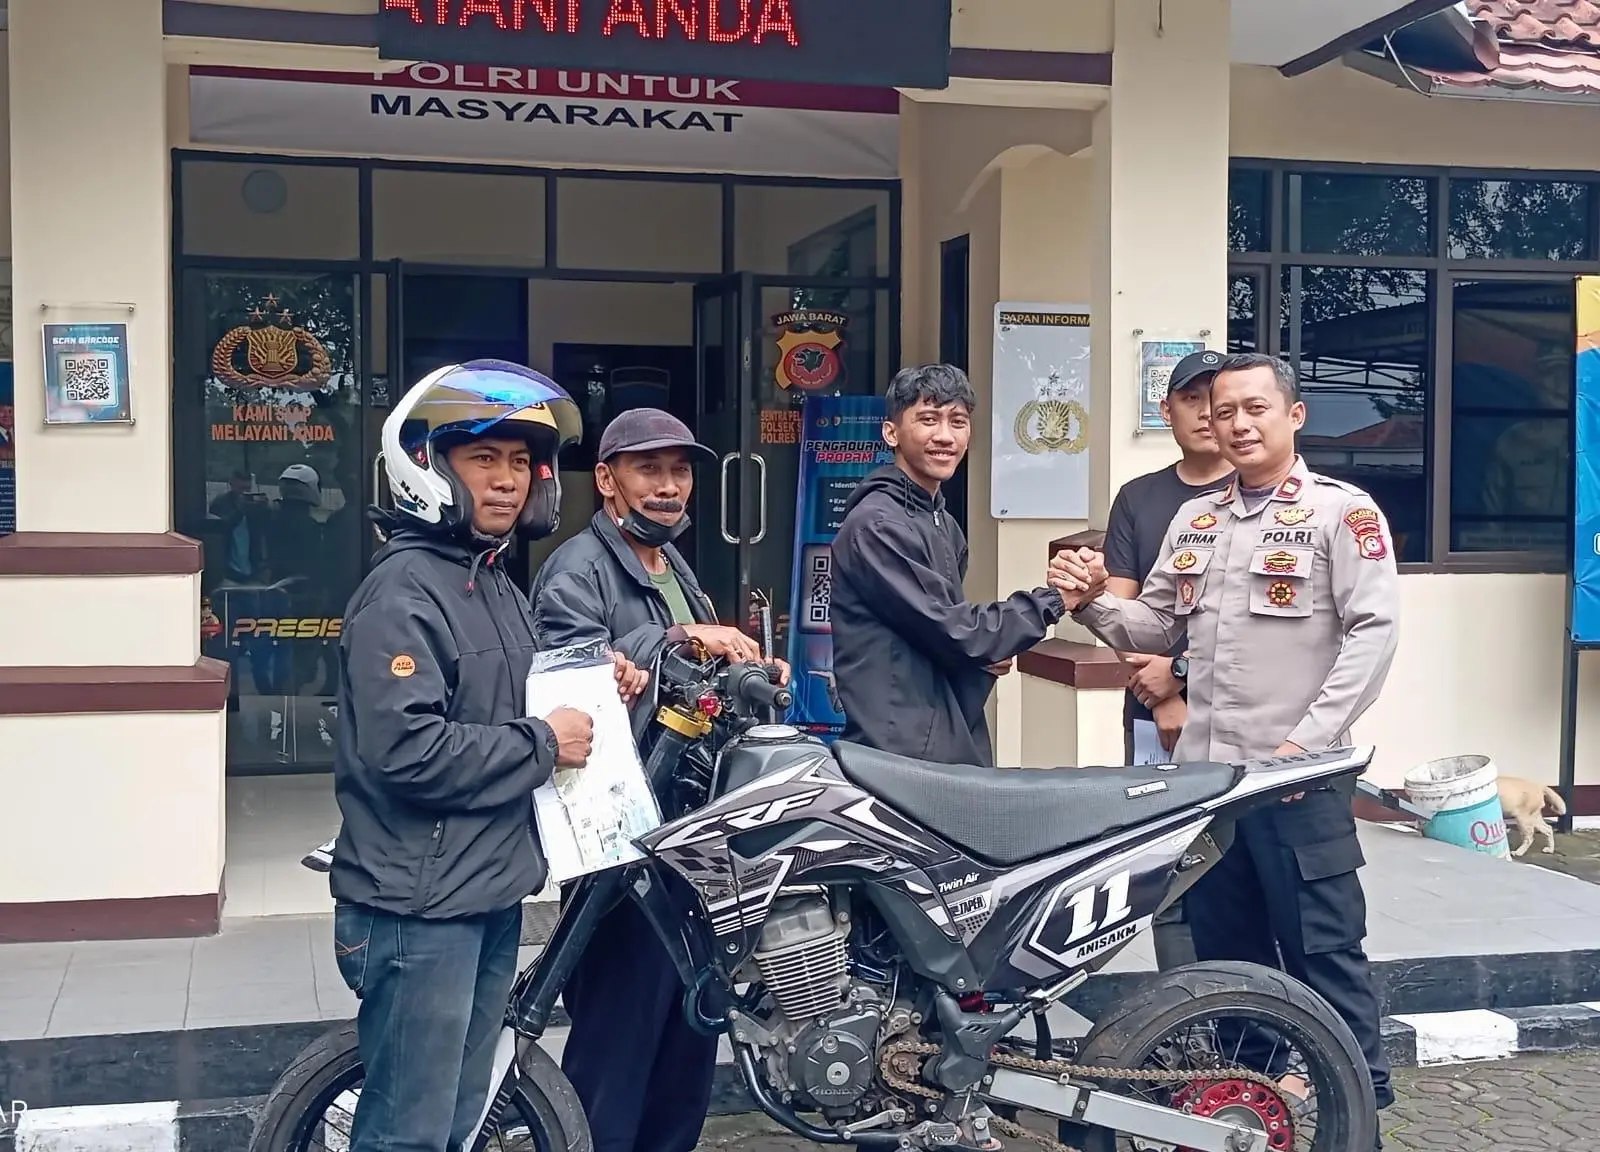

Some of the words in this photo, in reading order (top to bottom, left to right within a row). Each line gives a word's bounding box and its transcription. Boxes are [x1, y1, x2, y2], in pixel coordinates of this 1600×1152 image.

[373, 62, 537, 90] OLRI
[557, 70, 741, 101] UNTUK
[370, 93, 743, 132] MASYARAKAT
[777, 313, 807, 325] JAWA
[808, 313, 846, 326] BARAT
[1002, 313, 1040, 324] PAPAN
[52, 337, 77, 345] SCAN
[78, 335, 120, 344] BARCODE
[233, 404, 273, 421] KAMI
[211, 424, 288, 441] MELAYANI
[292, 425, 335, 441] ANDA
[760, 422, 795, 432] POLSEK
[760, 432, 796, 444] POLRES
[816, 451, 874, 463] PROPAM
[1176, 533, 1218, 545] FATHAN
[1262, 531, 1312, 543] POLRI
[654, 787, 827, 850] CRF
[938, 878, 963, 893] Twin
[964, 872, 980, 885] Air
[1063, 869, 1132, 946] 11
[1076, 923, 1137, 958] ANISAKM
